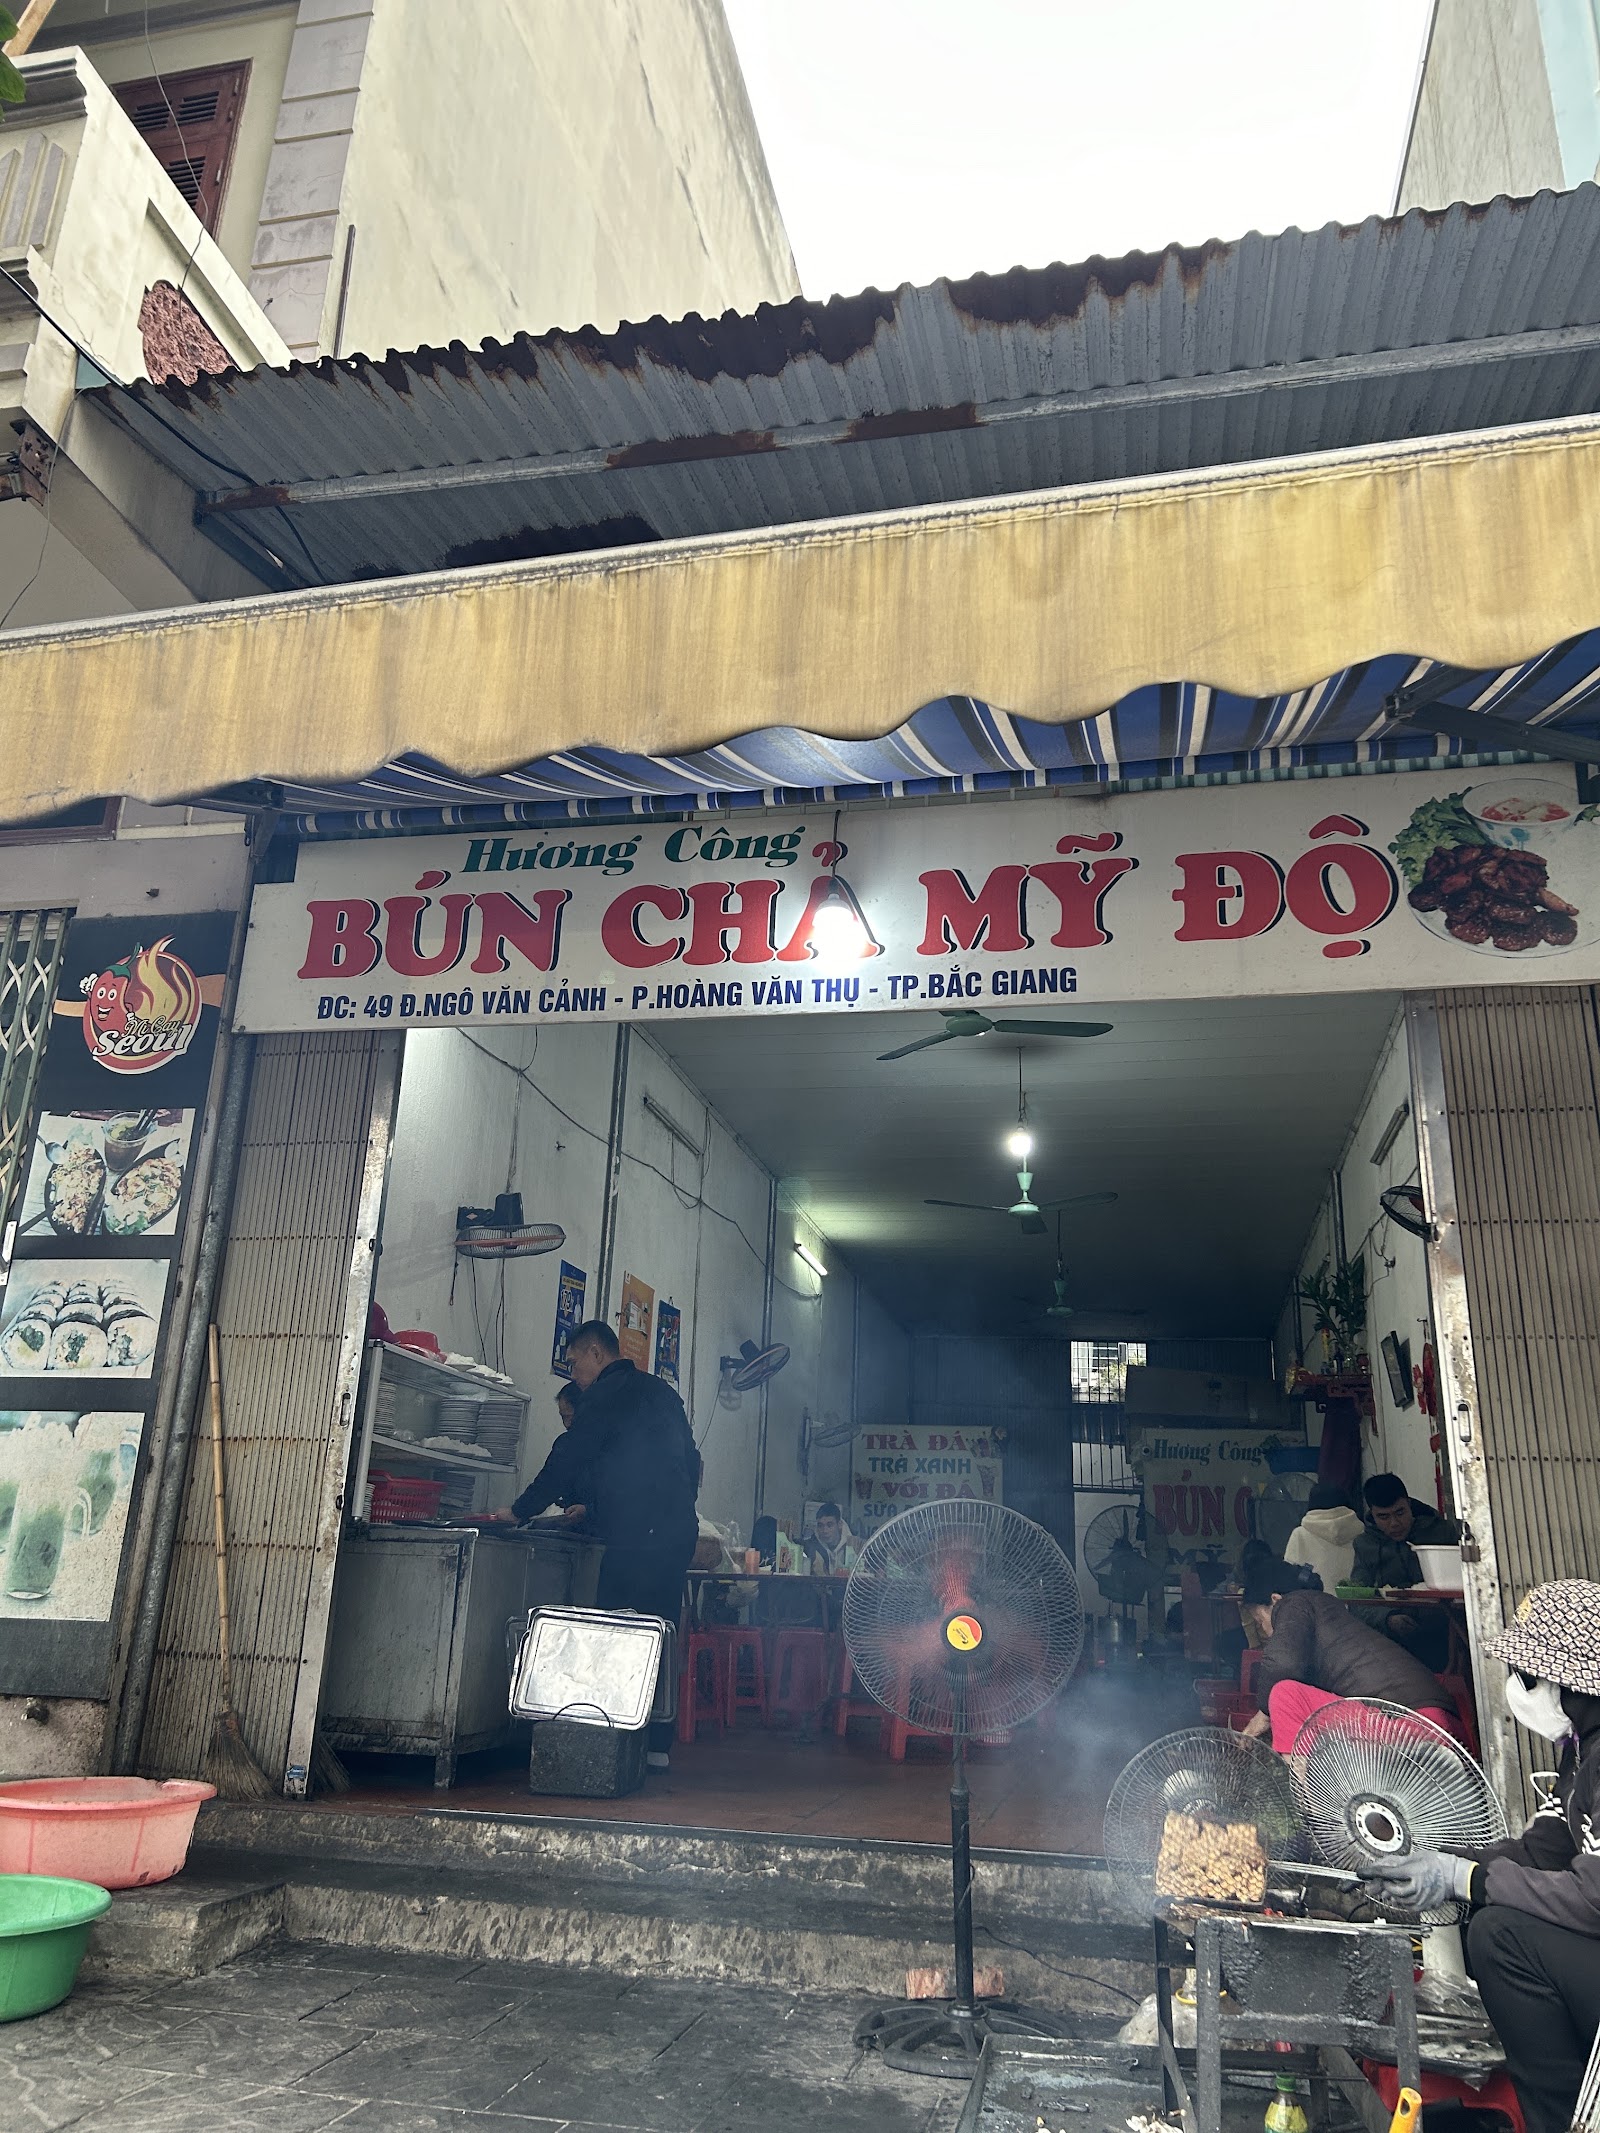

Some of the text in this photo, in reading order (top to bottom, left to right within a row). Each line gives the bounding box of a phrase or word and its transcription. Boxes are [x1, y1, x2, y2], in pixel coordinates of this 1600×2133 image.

[461, 825, 806, 876] Hương Công
[297, 813, 1400, 980] BÚN CHẢ MỸ ĐỘ
[317, 997, 357, 1020] ĐC:
[363, 994, 394, 1019] 49
[399, 986, 474, 1017] Đ.NGÔ
[482, 982, 533, 1014] VĂN
[537, 977, 607, 1012] CẢNH
[631, 975, 744, 1011] P.HOÀNG
[751, 973, 804, 1007] VĂN
[811, 977, 860, 1009] THỤ
[887, 965, 982, 1000] TP.BẮC
[991, 967, 1077, 994] GIANG
[92, 1024, 192, 1056] Seoul
[862, 1430, 969, 1450] TRÀ ĐÁ
[1153, 1438, 1263, 1466] Hương Công
[868, 1454, 971, 1475] TRÀ XANH
[1152, 1469, 1226, 1537] BÚN
